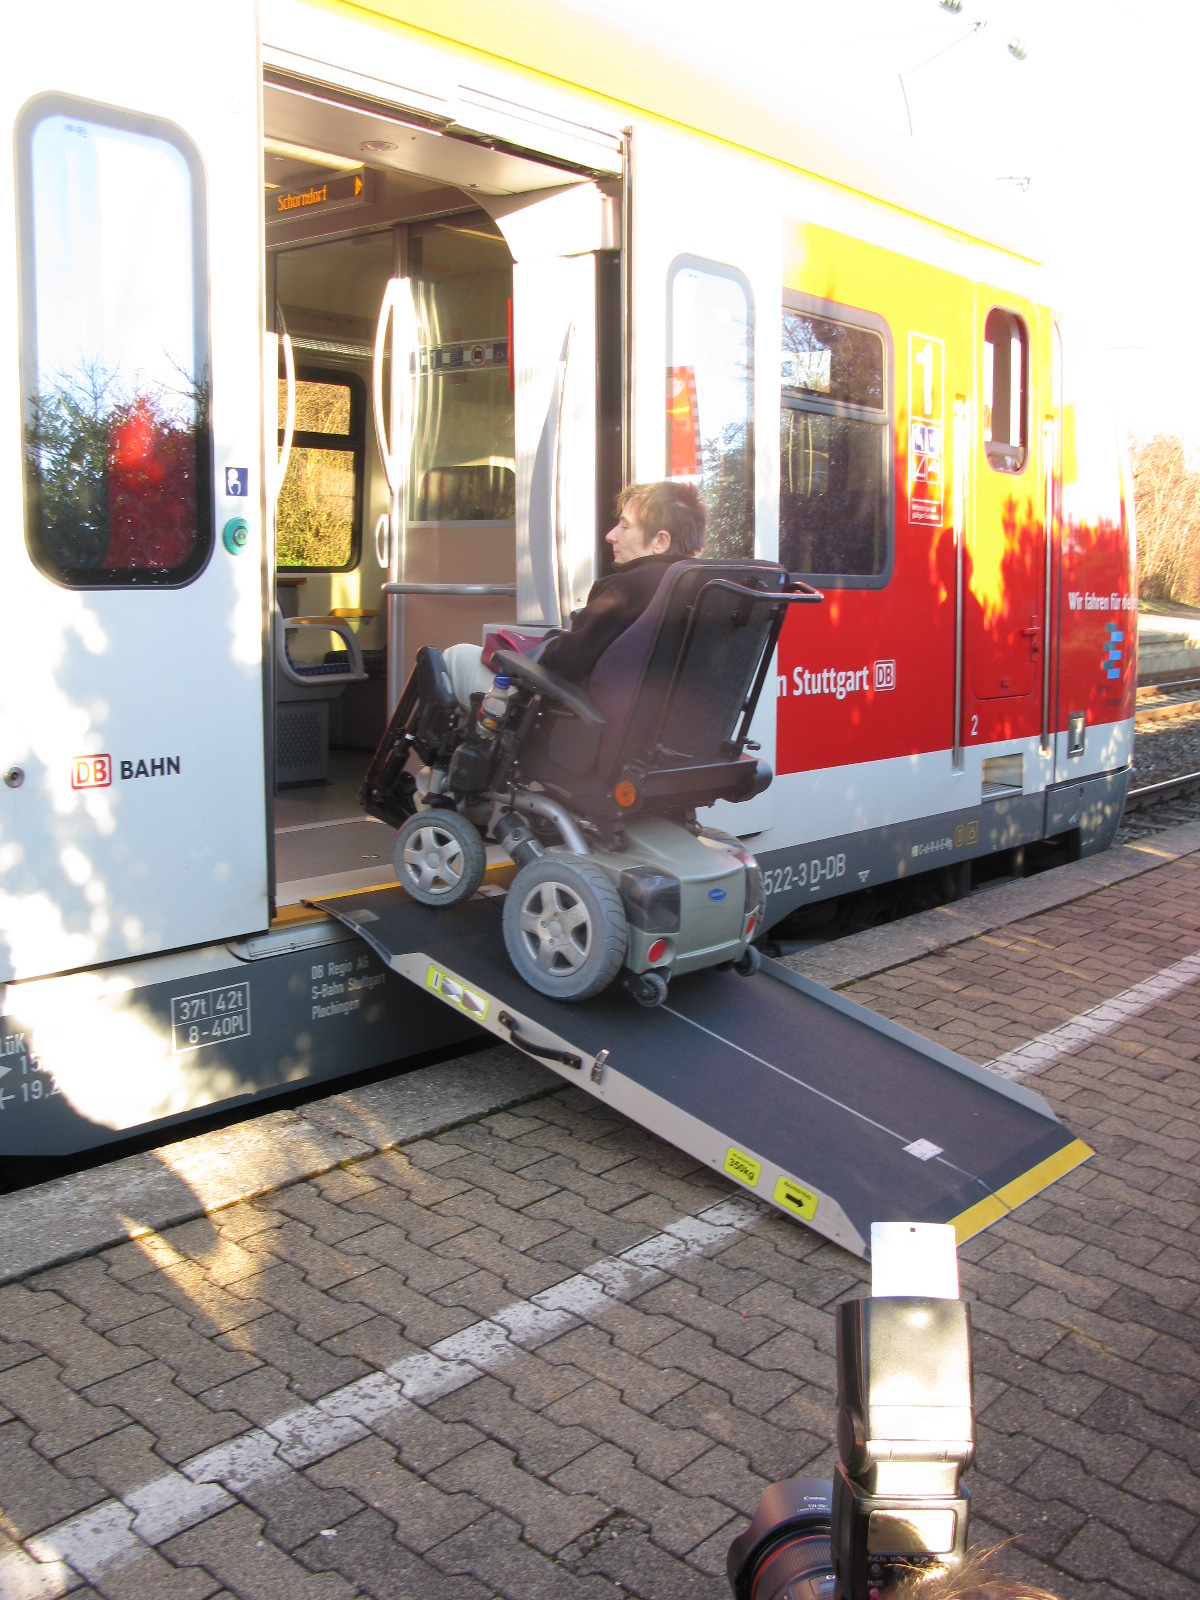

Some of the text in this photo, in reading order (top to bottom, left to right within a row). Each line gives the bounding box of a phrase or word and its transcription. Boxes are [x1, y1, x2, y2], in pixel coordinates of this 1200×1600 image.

[278, 184, 327, 212] Schorndorf
[915, 342, 933, 415] 1
[1068, 591, 1083, 611] Wir
[1084, 591, 1109, 611] fahren
[1110, 592, 1121, 611] für
[792, 666, 870, 700] Stuttgart
[875, 663, 894, 688] DB
[971, 714, 979, 736] 2
[75, 755, 181, 786] DB BAHN
[311, 954, 369, 980] DB Regio AG
[311, 973, 386, 1000] S-Bahn Stuttgart
[180, 998, 207, 1021] 37t
[216, 990, 243, 1011] 42t
[311, 999, 361, 1020] Plochingen
